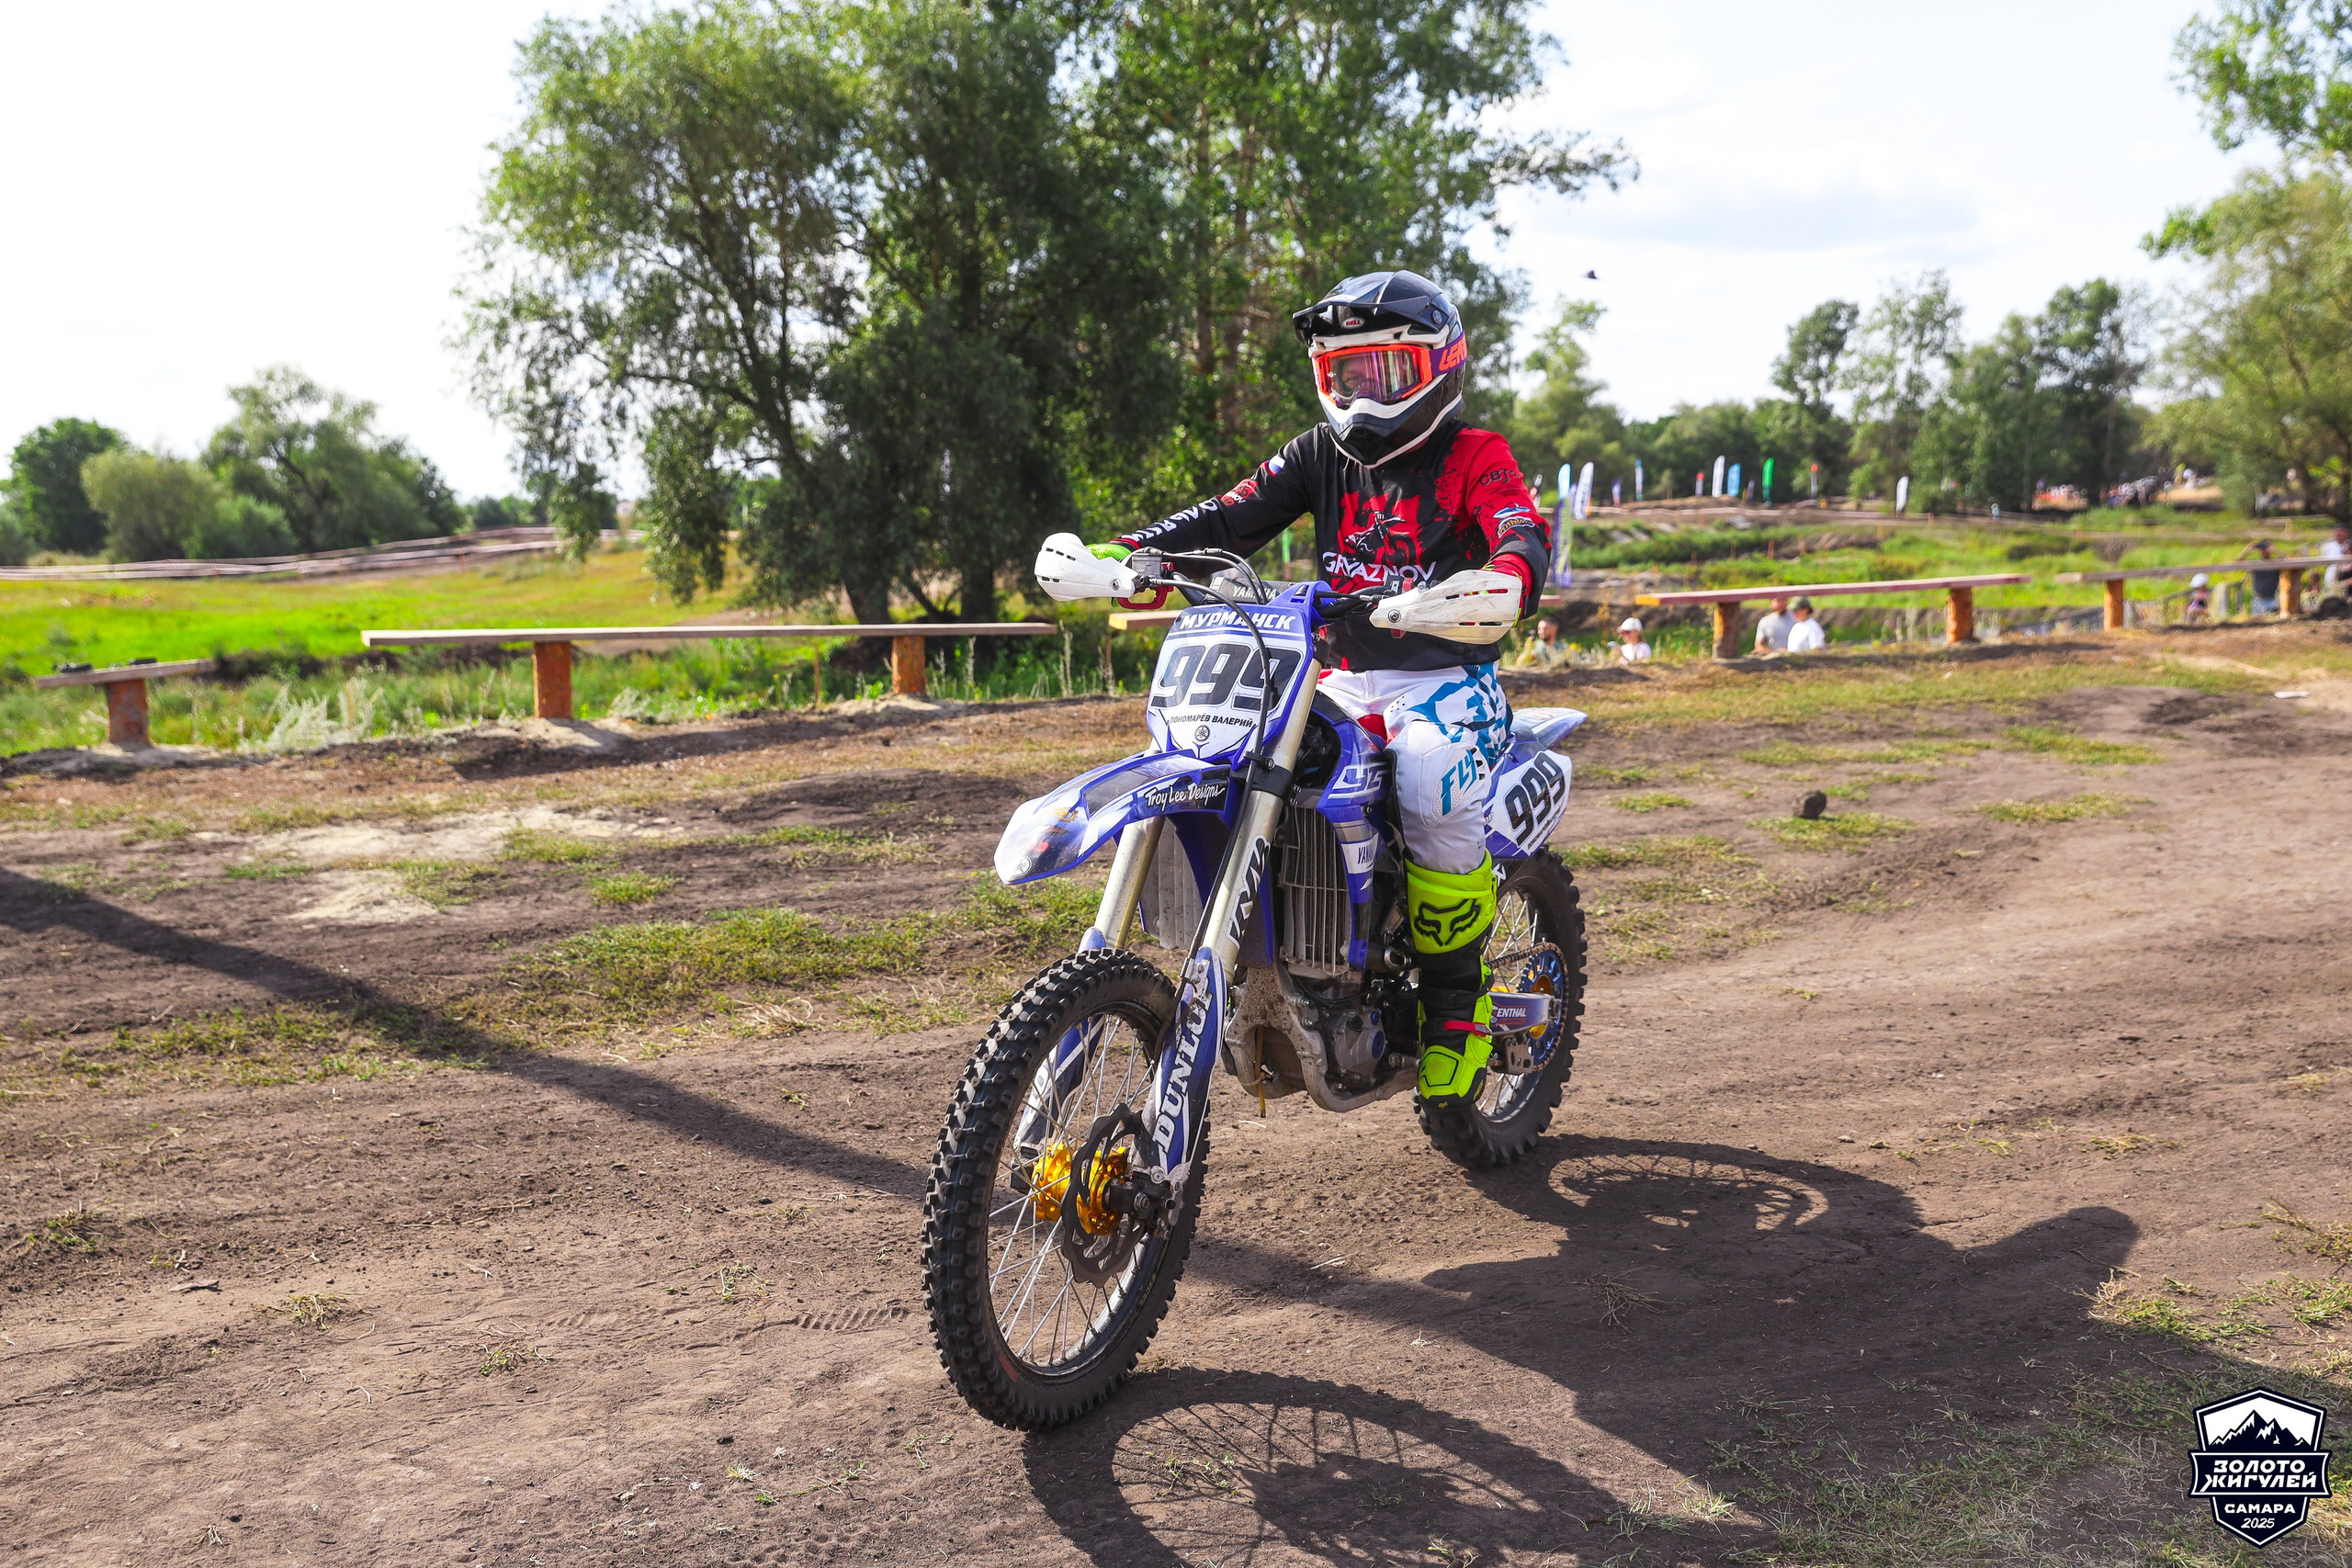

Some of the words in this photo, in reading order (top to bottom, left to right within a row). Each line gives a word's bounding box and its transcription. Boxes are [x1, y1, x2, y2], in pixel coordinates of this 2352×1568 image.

[1180, 611, 1296, 630] МУРМАНСК
[1149, 643, 1303, 713] 999
[1211, 715, 1253, 728] ВАЛЕРИЙ
[1145, 786, 1168, 812] Troy
[1169, 785, 1186, 804] Lee
[1187, 783, 1226, 806] Designs
[1441, 749, 1477, 817] FLY
[1504, 751, 1566, 848] 999
[1152, 976, 1214, 1153] DUNLOP
